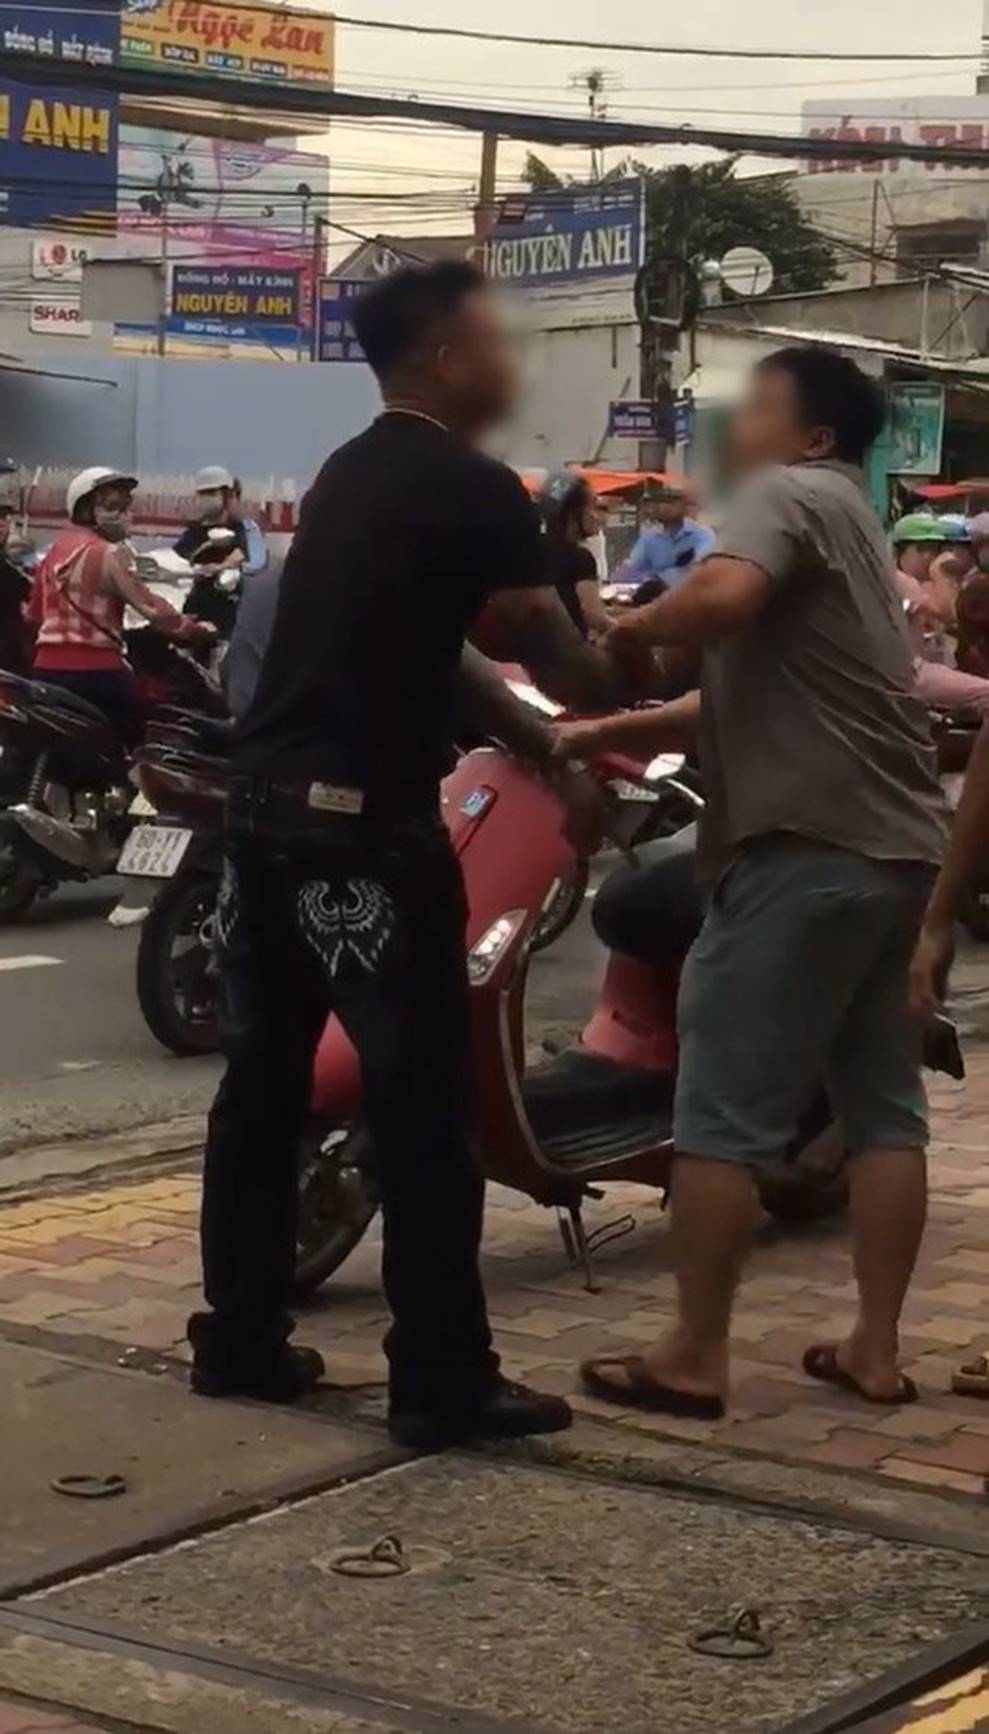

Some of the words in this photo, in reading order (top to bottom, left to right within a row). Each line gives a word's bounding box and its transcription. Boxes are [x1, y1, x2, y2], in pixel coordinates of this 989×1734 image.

[21, 99, 110, 154] ANH
[577, 223, 633, 269] ANH
[34, 305, 80, 323] SHAR
[256, 295, 292, 316] ANH
